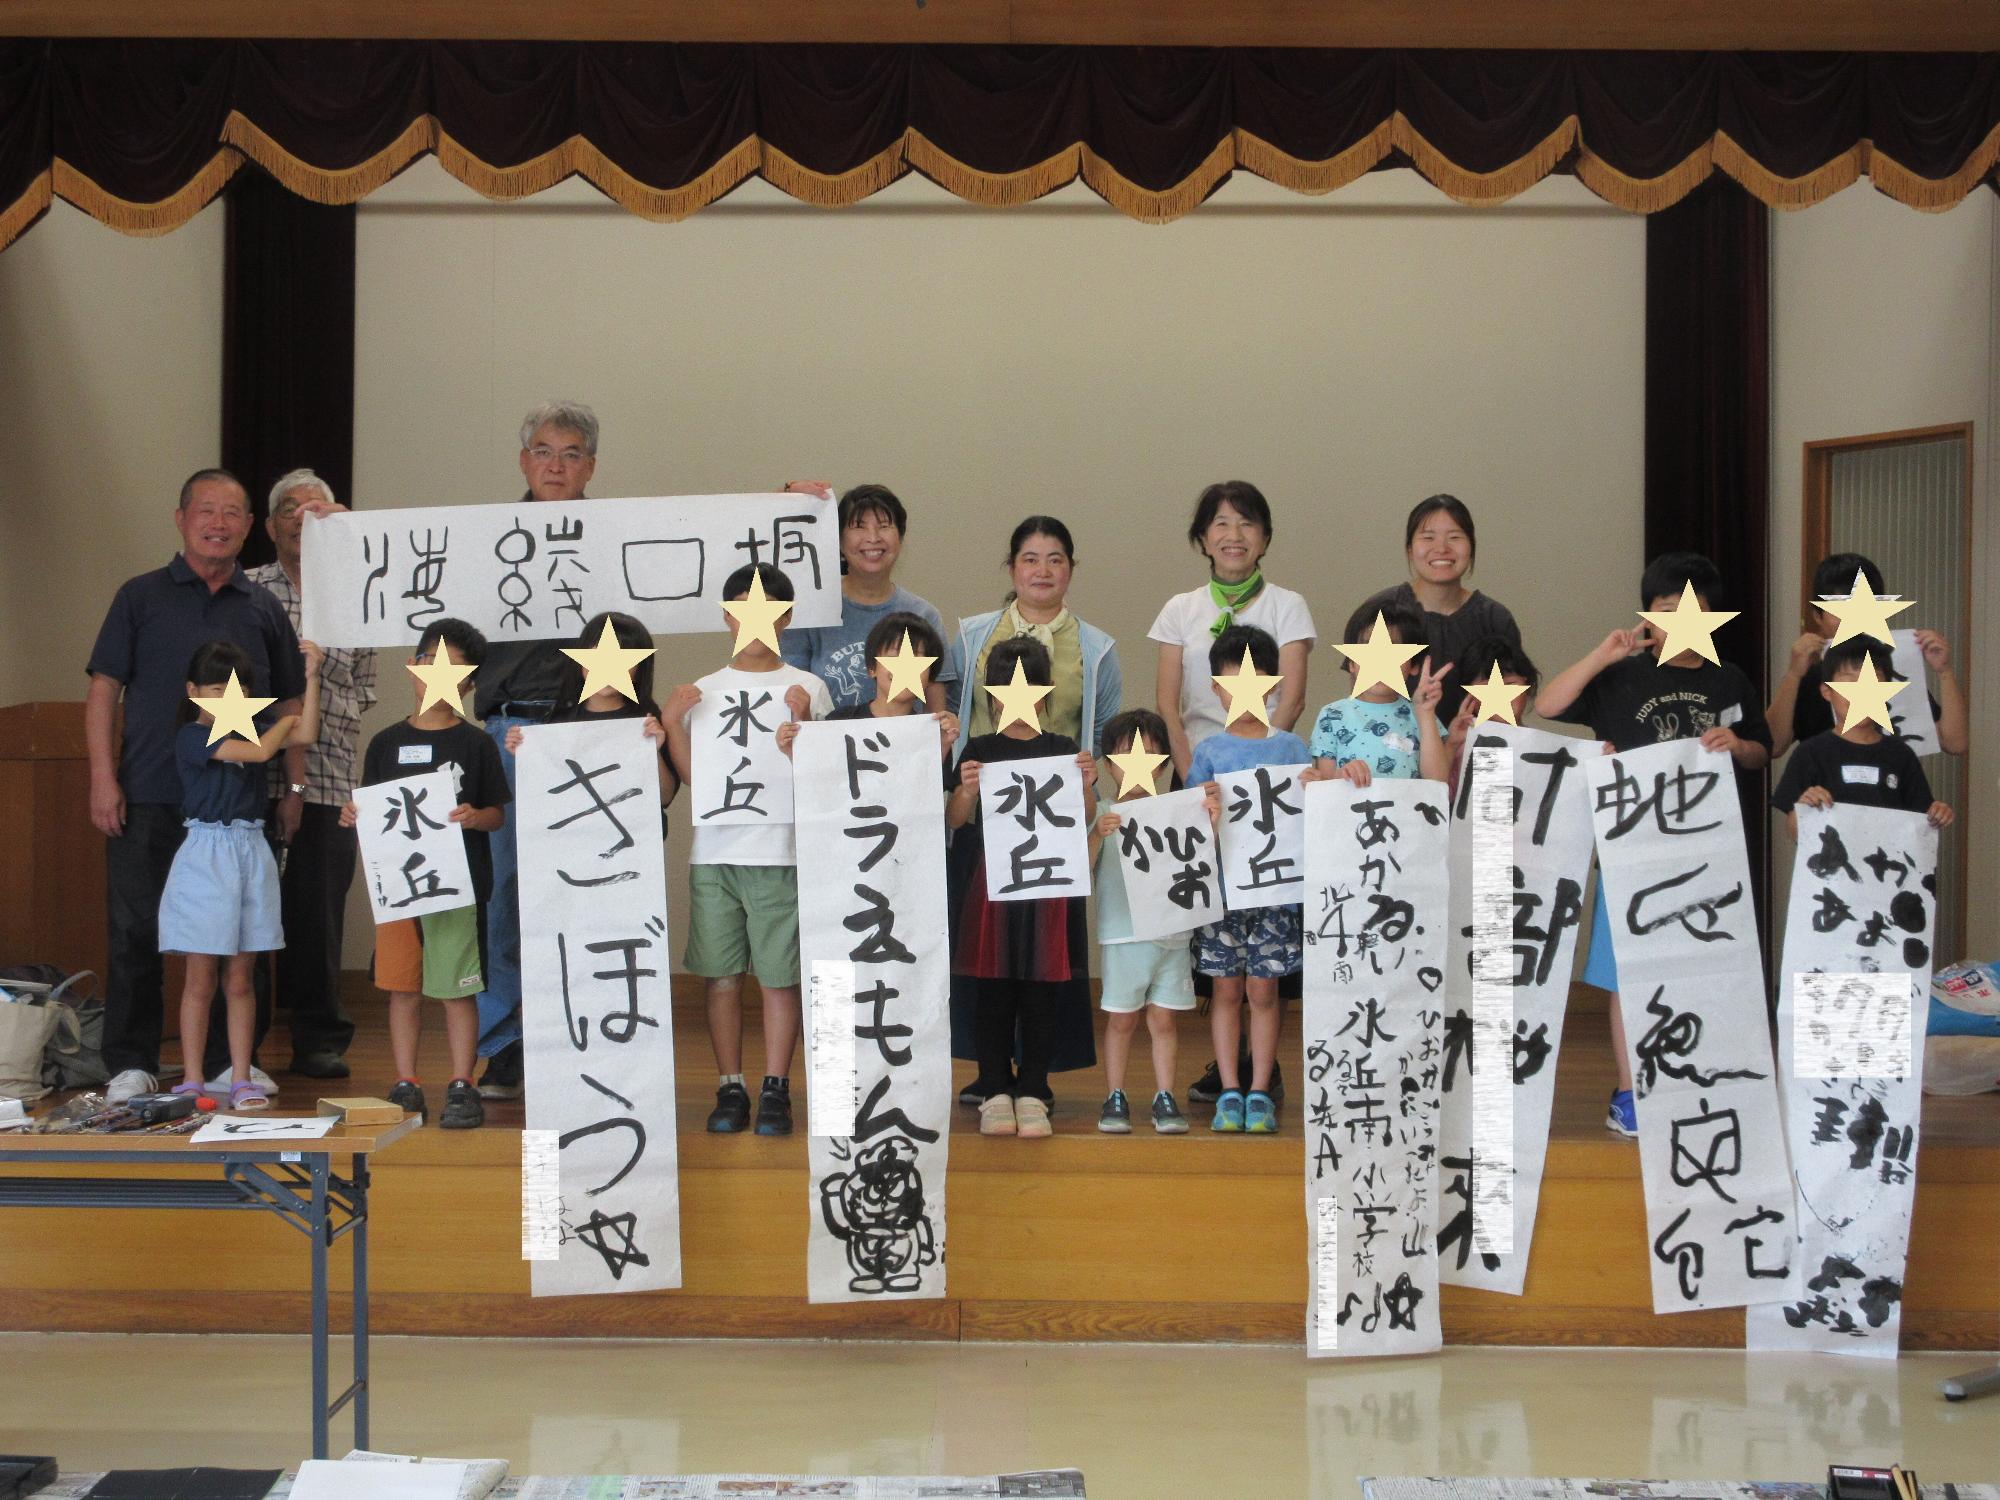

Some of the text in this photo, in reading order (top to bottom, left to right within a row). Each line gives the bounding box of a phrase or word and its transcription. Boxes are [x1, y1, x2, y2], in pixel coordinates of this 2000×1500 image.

[700, 690, 775, 820] 氷丘
[1635, 692, 1709, 723] JUDY and NICK
[381, 786, 460, 908] 氷丘
[992, 771, 1076, 894] 氷丘
[1228, 767, 1304, 890] 氷丘
[1334, 997, 1398, 1277] 氷丘南小学校
